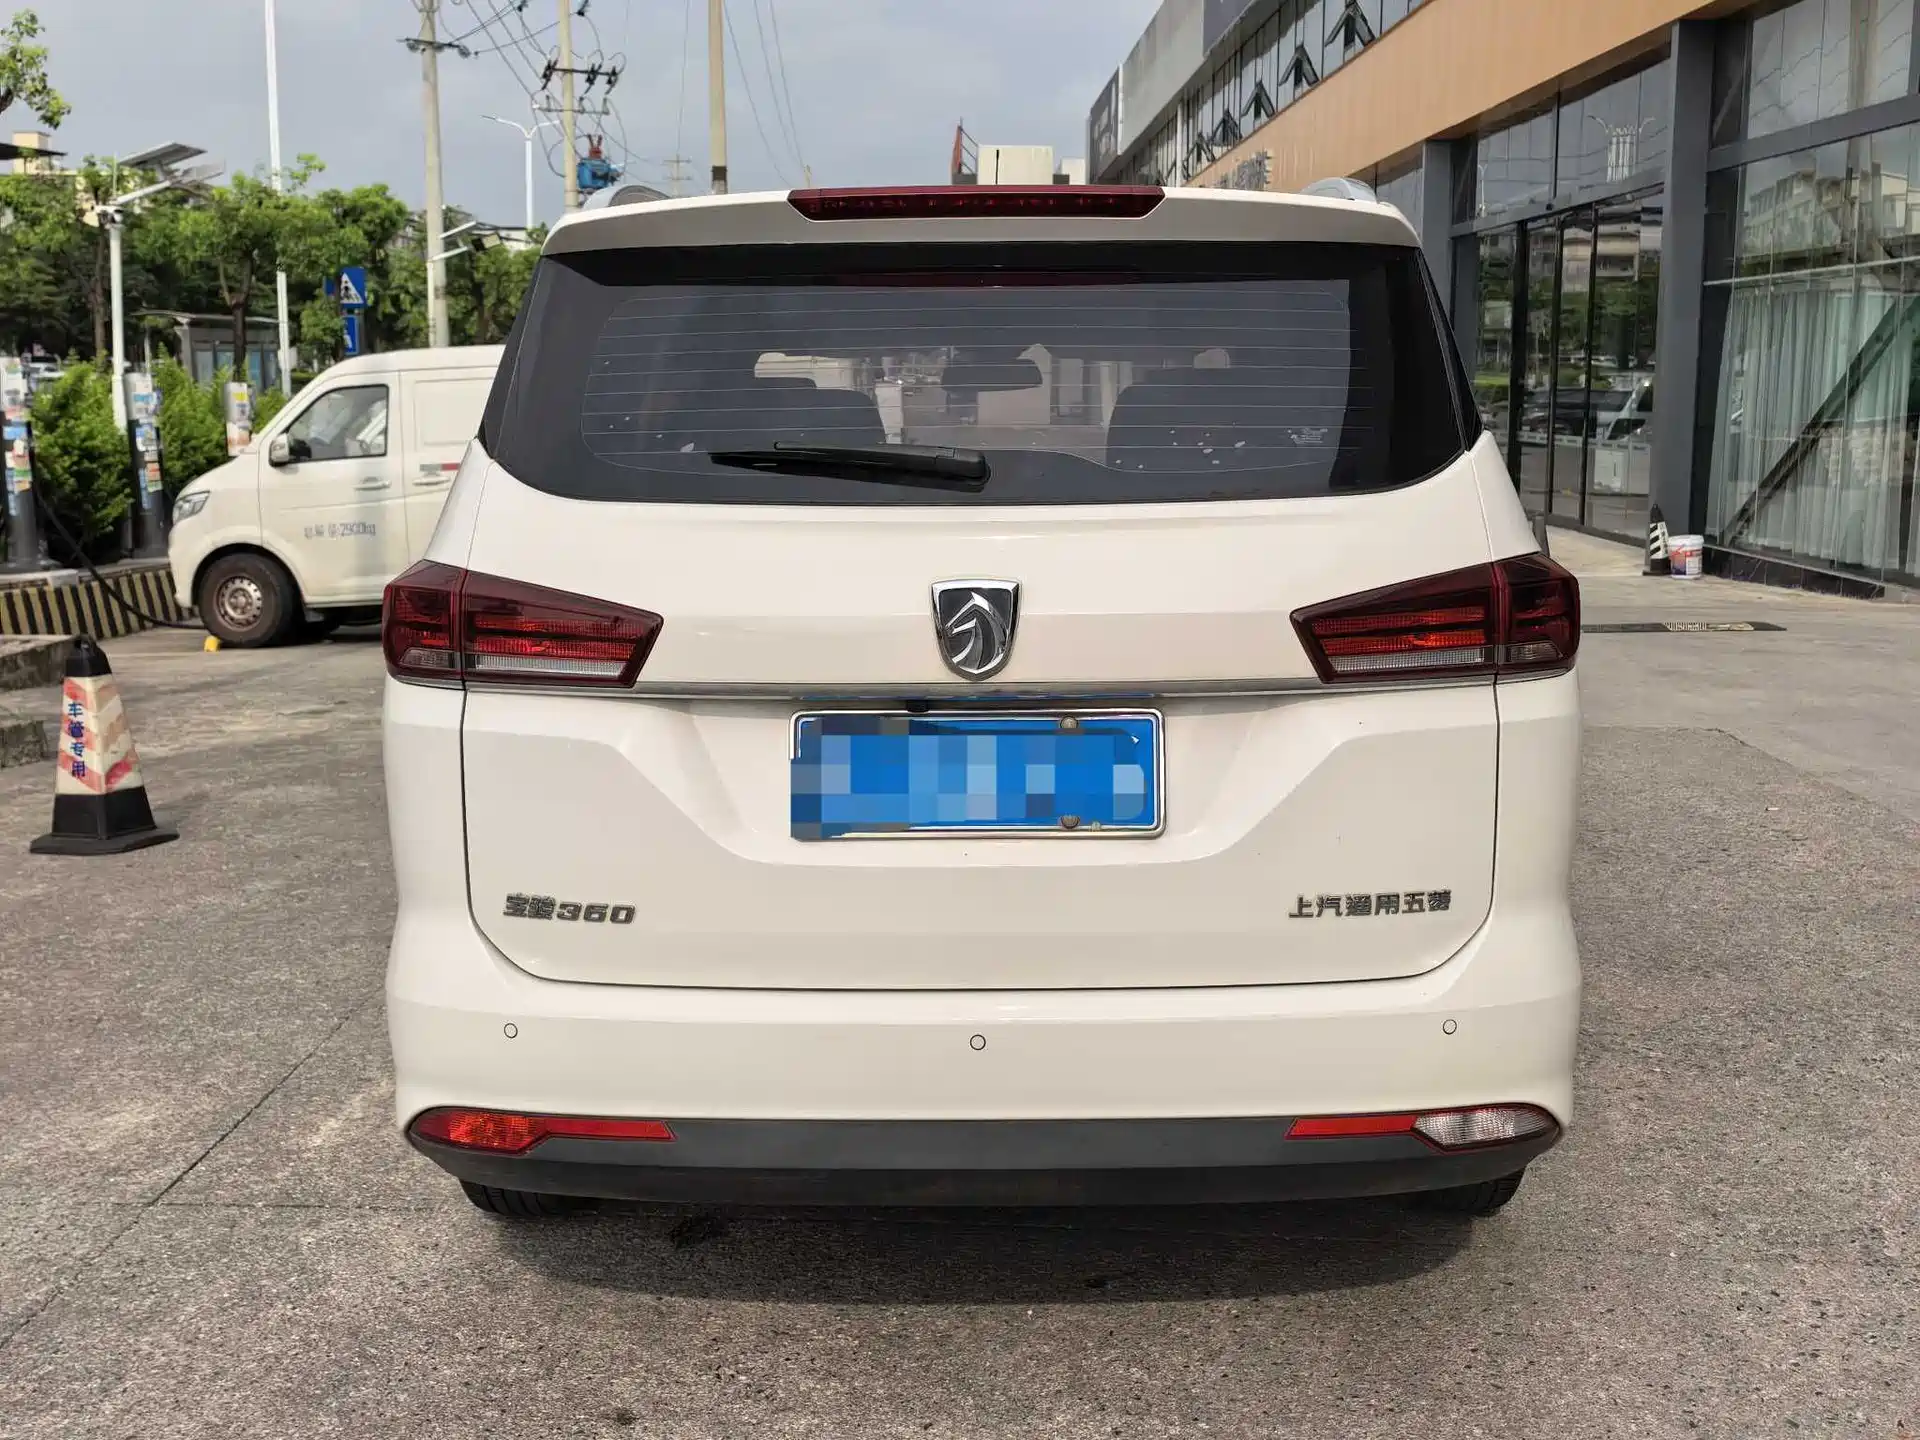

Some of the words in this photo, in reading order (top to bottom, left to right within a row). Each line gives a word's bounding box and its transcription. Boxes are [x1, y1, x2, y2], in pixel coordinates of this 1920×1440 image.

[503, 893, 636, 925] 宝骏360
[1289, 889, 1452, 918] 上汽通用五菱
